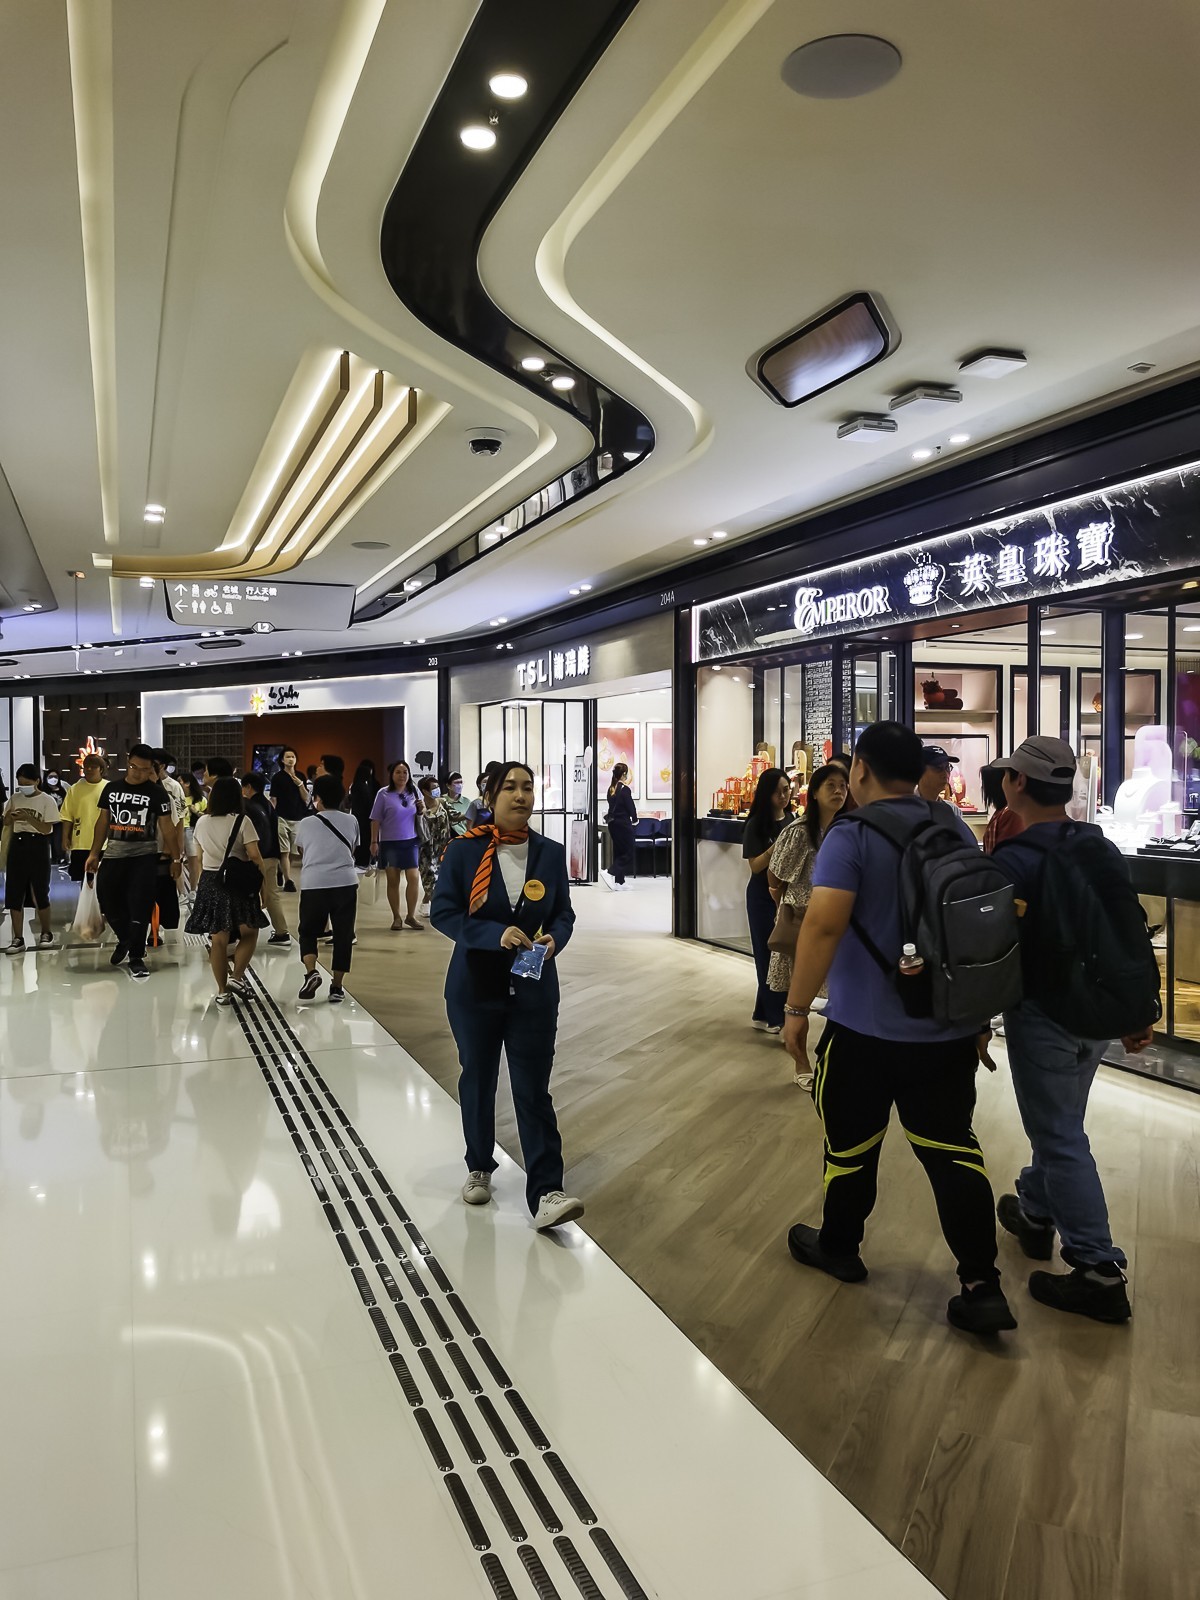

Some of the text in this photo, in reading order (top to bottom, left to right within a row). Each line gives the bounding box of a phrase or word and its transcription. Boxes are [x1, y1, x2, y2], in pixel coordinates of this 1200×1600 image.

[959, 521, 1114, 597] 英皇珠寶
[660, 590, 675, 606] 204A
[794, 585, 892, 634] EMPEROR
[257, 623, 269, 632] L2
[428, 657, 438, 666] 203
[516, 659, 548, 687] TSL
[108, 792, 151, 807] SUPER
